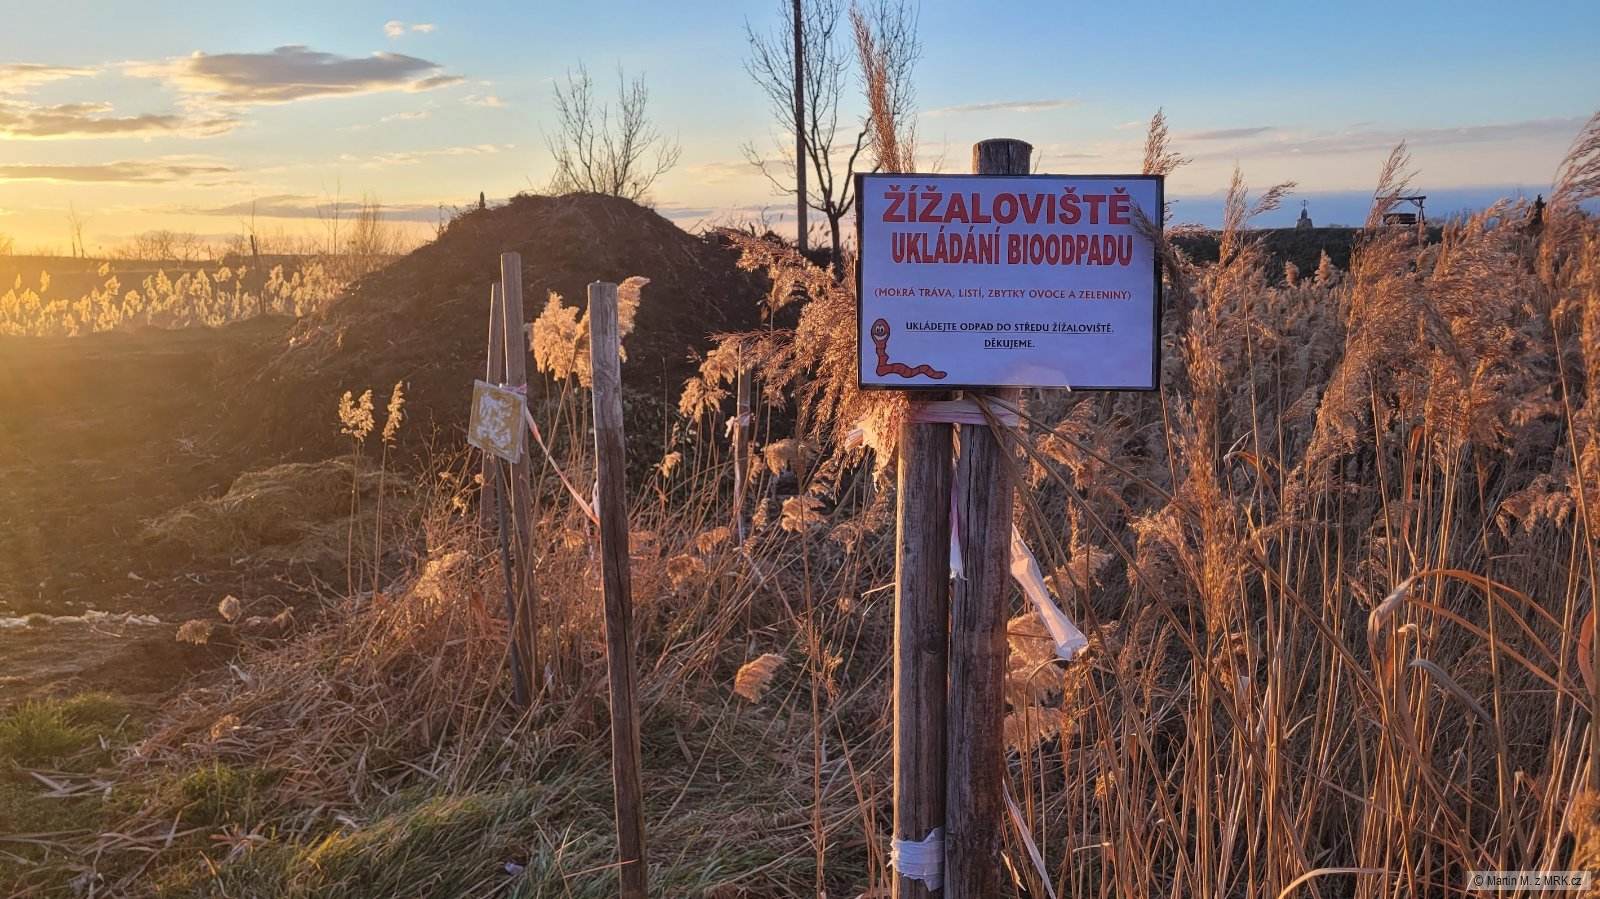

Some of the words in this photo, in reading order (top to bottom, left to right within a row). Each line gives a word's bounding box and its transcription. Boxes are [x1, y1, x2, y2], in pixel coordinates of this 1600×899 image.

[882, 185, 1131, 225] ŽÍŽALOVIŠTĚ
[891, 226, 1001, 265] UKLÁDÁNÍ
[1007, 233, 1133, 266] BIOODPADU
[874, 286, 916, 298] (MOKRÁ
[918, 286, 955, 299] TRÁVA,
[959, 287, 985, 300] LISTÍ,
[988, 288, 1025, 299] ZBYTKY
[1028, 289, 1066, 299] OVOCE
[1068, 289, 1076, 299] A
[1079, 290, 1132, 301] ZELENINY)
[905, 320, 958, 333] UKLÁDEJTE
[960, 322, 994, 332] ODPAD
[996, 322, 1012, 332] DO
[1014, 321, 1050, 332] STŘEDU
[984, 338, 1036, 350] DĚKUJEME.
